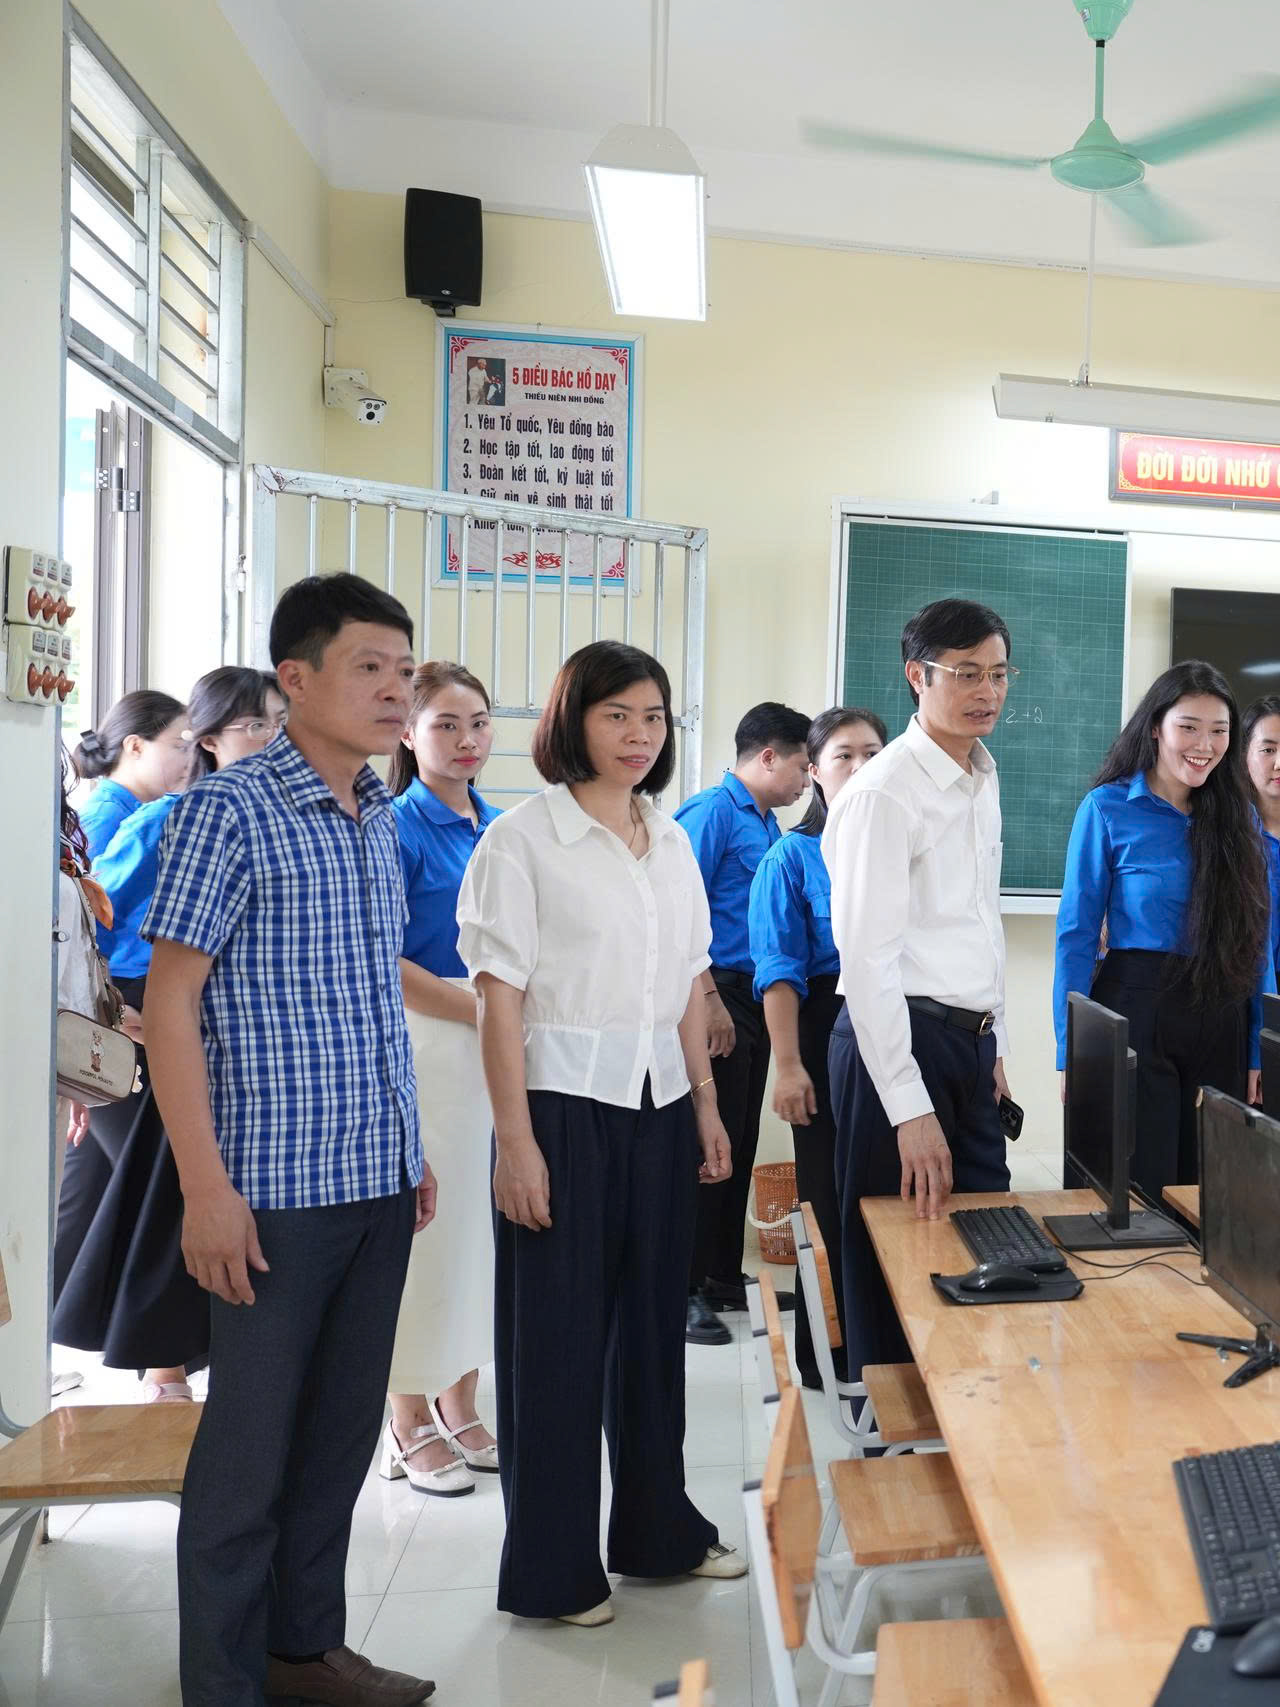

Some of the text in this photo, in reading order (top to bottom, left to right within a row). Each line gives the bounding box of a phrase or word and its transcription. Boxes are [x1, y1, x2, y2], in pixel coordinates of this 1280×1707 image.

[512, 362, 617, 395] 5 ĐIỀU BÁC HỒ DẠY
[568, 395, 582, 403] NHI
[464, 413, 472, 429] 1.
[478, 413, 495, 430] Yêu
[500, 412, 512, 431] Tổ
[516, 414, 542, 435] quốc,
[547, 418, 564, 434] Yêu
[569, 417, 592, 438] đồng
[463, 438, 614, 463] 2. Học tập tốt, lao động tốt
[463, 463, 614, 488] 3. Đoàn kết tốt, kỷ luật tốt
[1224, 452, 1272, 488] NHỚ
[547, 494, 567, 509] sinh
[575, 493, 593, 512] thật
[601, 491, 613, 511] tốt
